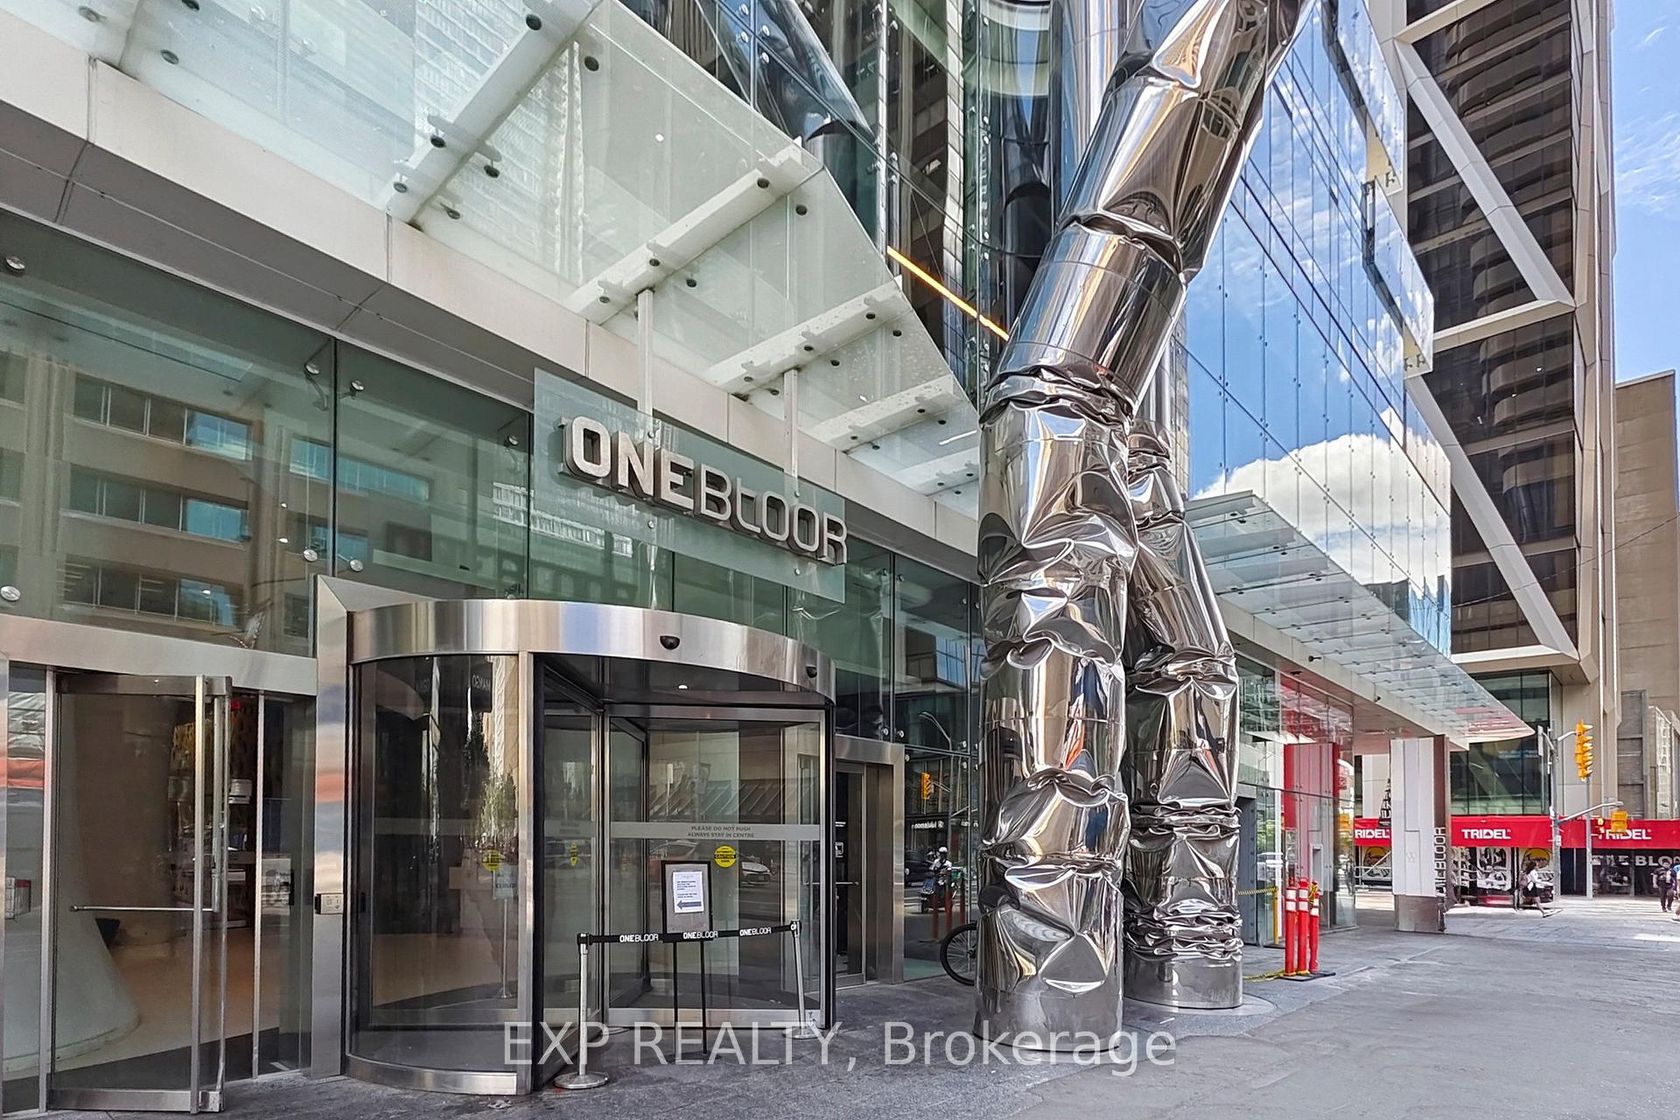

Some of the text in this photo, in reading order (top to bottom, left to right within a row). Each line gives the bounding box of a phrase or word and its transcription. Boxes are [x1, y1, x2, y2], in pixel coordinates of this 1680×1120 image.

[563, 415, 848, 565] ONEBLOOR
[1355, 828, 1390, 839] RIDEL
[1461, 829, 1511, 840] TRIDEL
[683, 931, 719, 940] ONEBLOOR
[739, 927, 772, 937] ONEBLOOR
[619, 933, 659, 943] ONEBLOOR
